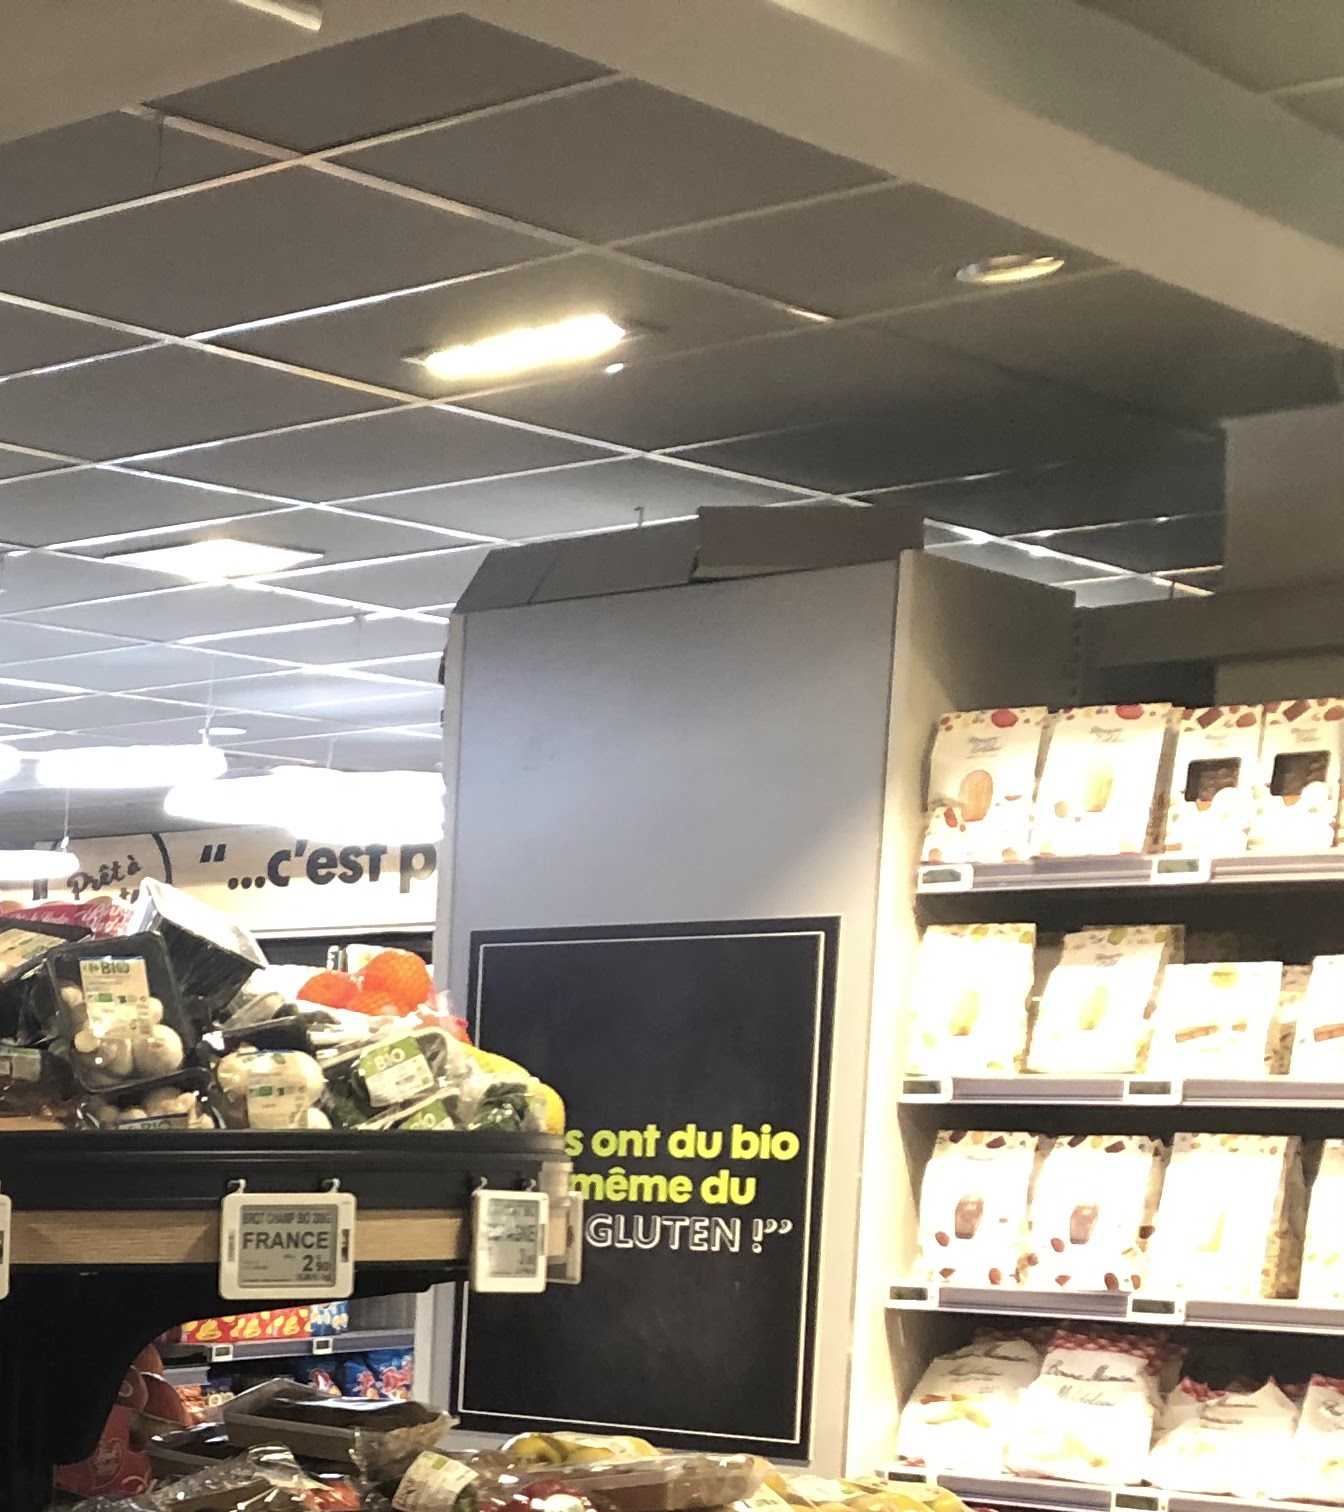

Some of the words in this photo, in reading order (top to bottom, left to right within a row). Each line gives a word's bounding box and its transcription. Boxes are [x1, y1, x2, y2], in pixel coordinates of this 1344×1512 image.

[591, 1124, 661, 1157] ont
[668, 1124, 723, 1159] du
[731, 1124, 800, 1161] bio
[568, 1166, 693, 1203] même
[700, 1169, 757, 1205] du
[242, 1231, 329, 1250] FRANCE
[585, 1212, 741, 1252] GLUTEN
